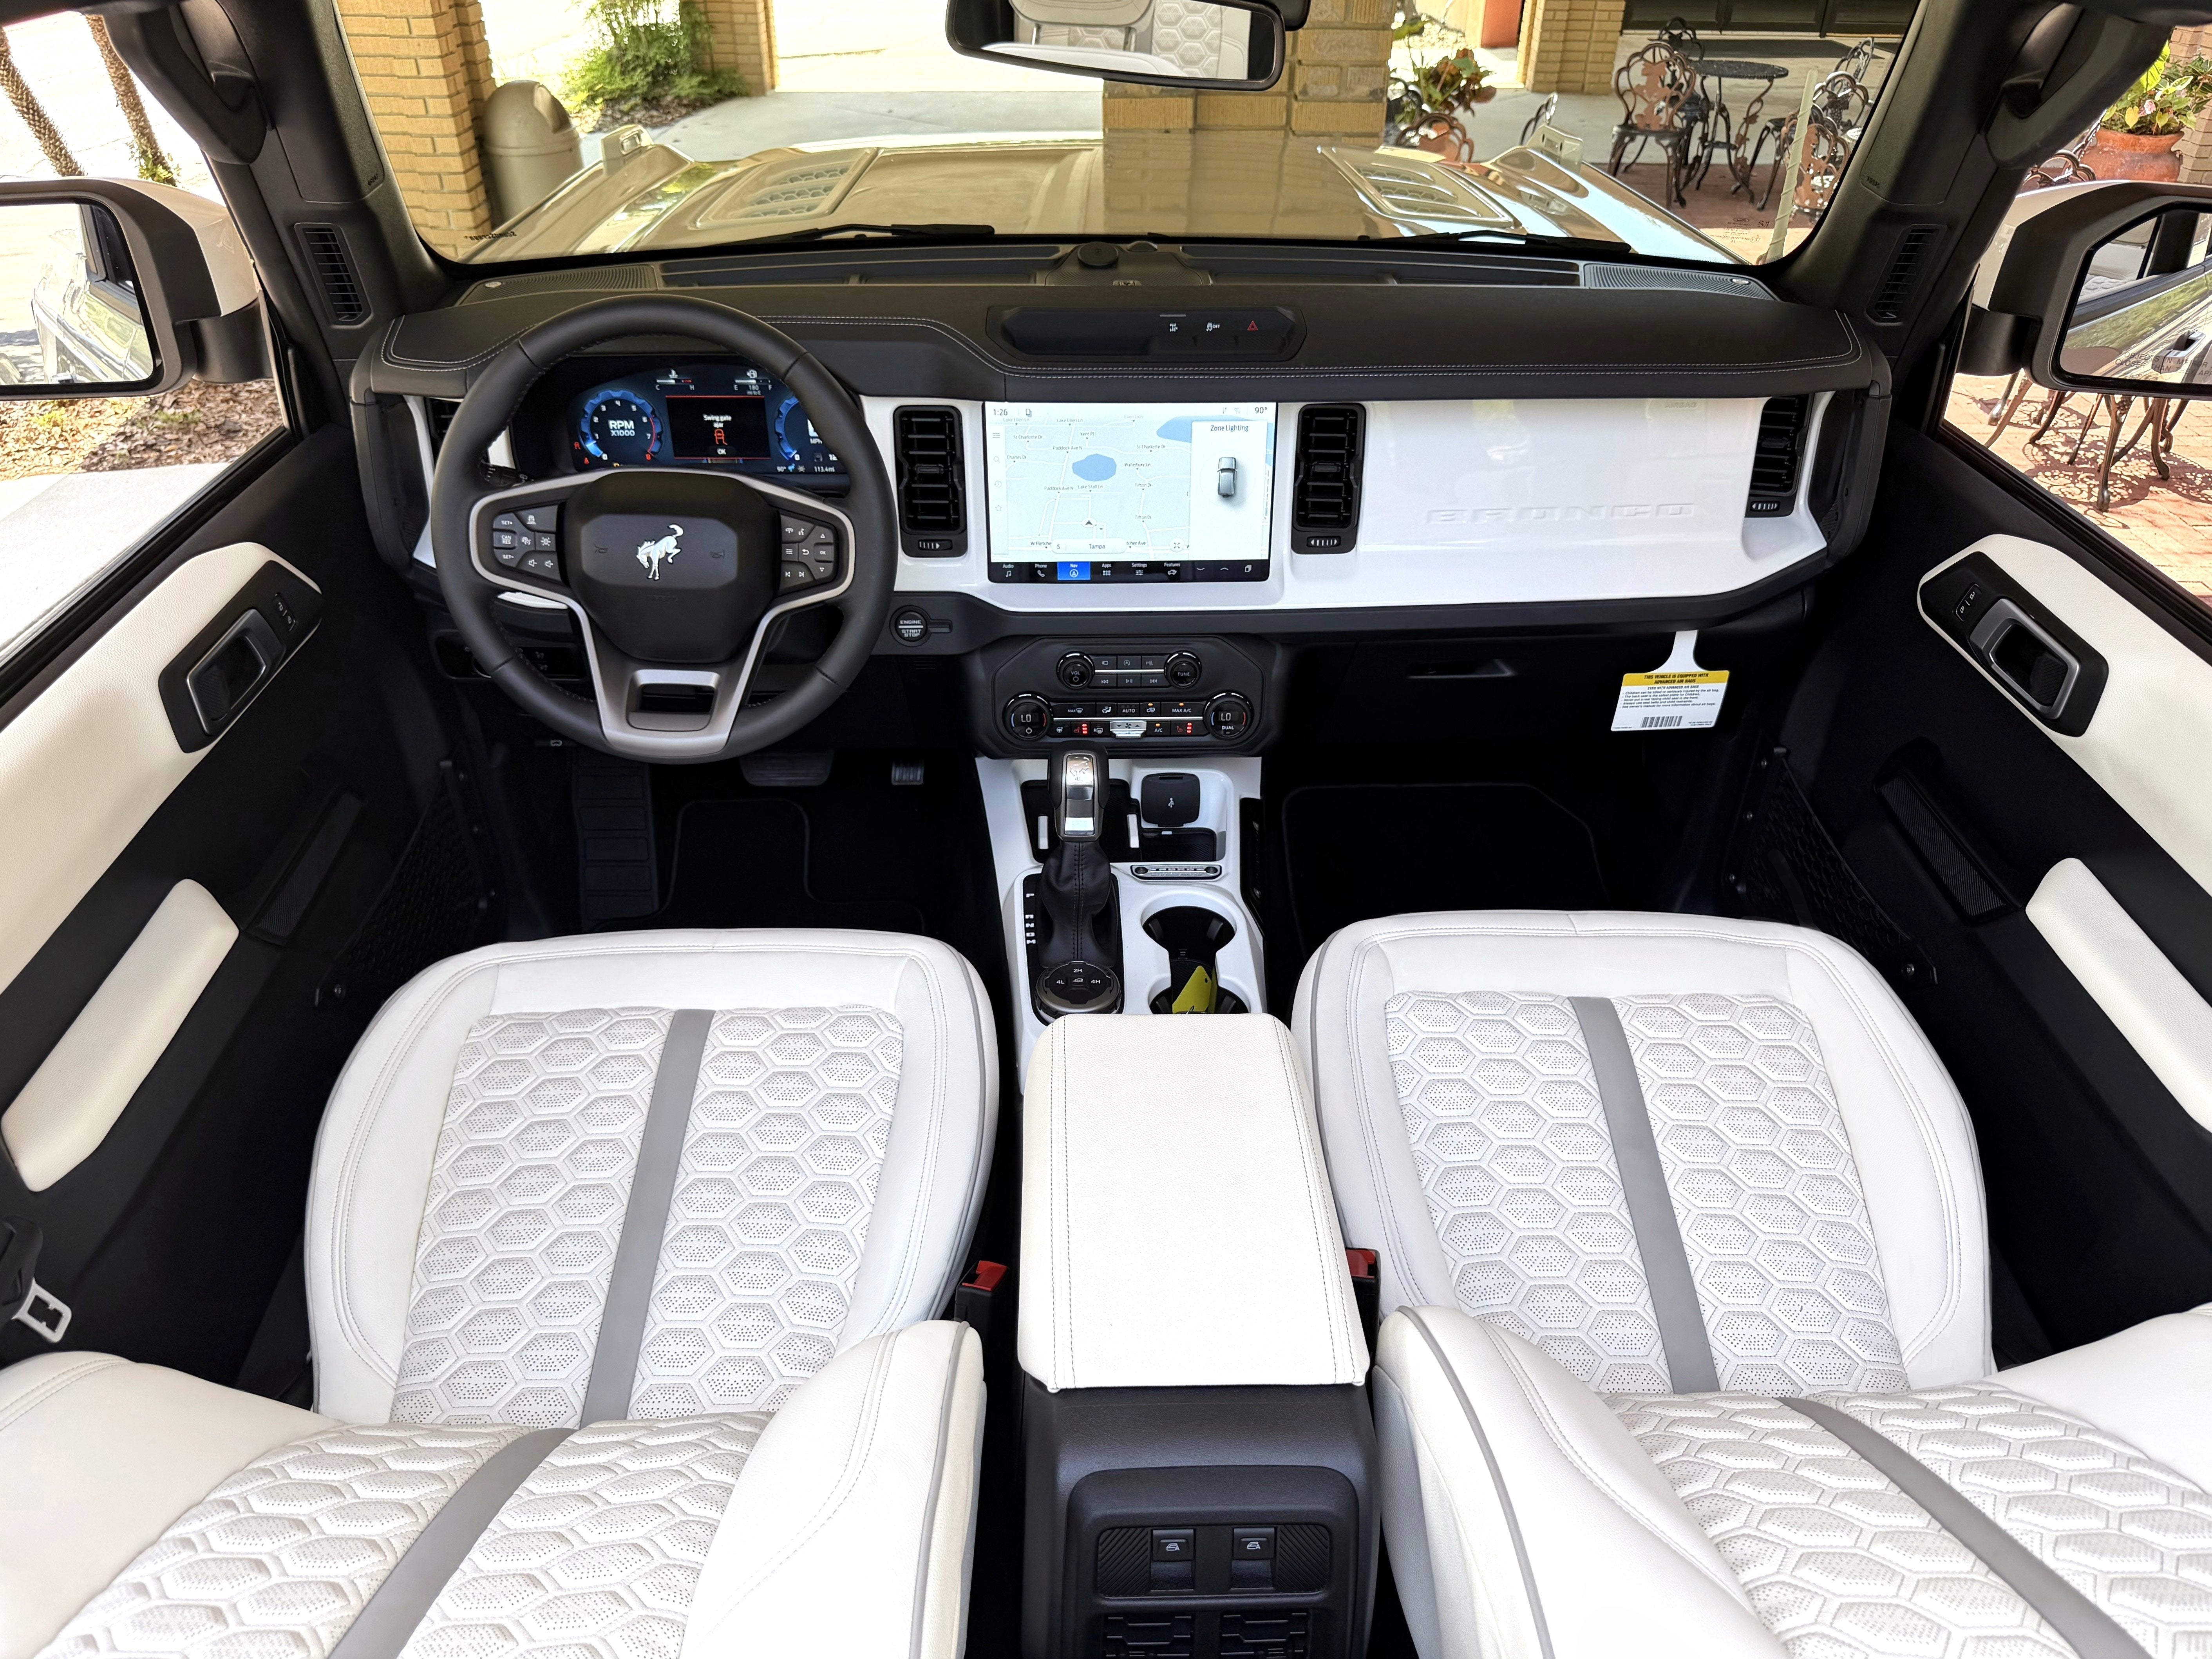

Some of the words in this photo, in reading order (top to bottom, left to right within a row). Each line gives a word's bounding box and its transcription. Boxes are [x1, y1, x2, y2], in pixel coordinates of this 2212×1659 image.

[2124, 352, 2160, 362] OBJECTS
[2115, 358, 2146, 368] CLOSER
[2151, 364, 2171, 372] THAN
[702, 413, 720, 422] Swing
[608, 419, 635, 430] RPM
[1427, 503, 1695, 524] BRONCO
[1021, 714, 1031, 723] LO
[1221, 712, 1231, 722] LO
